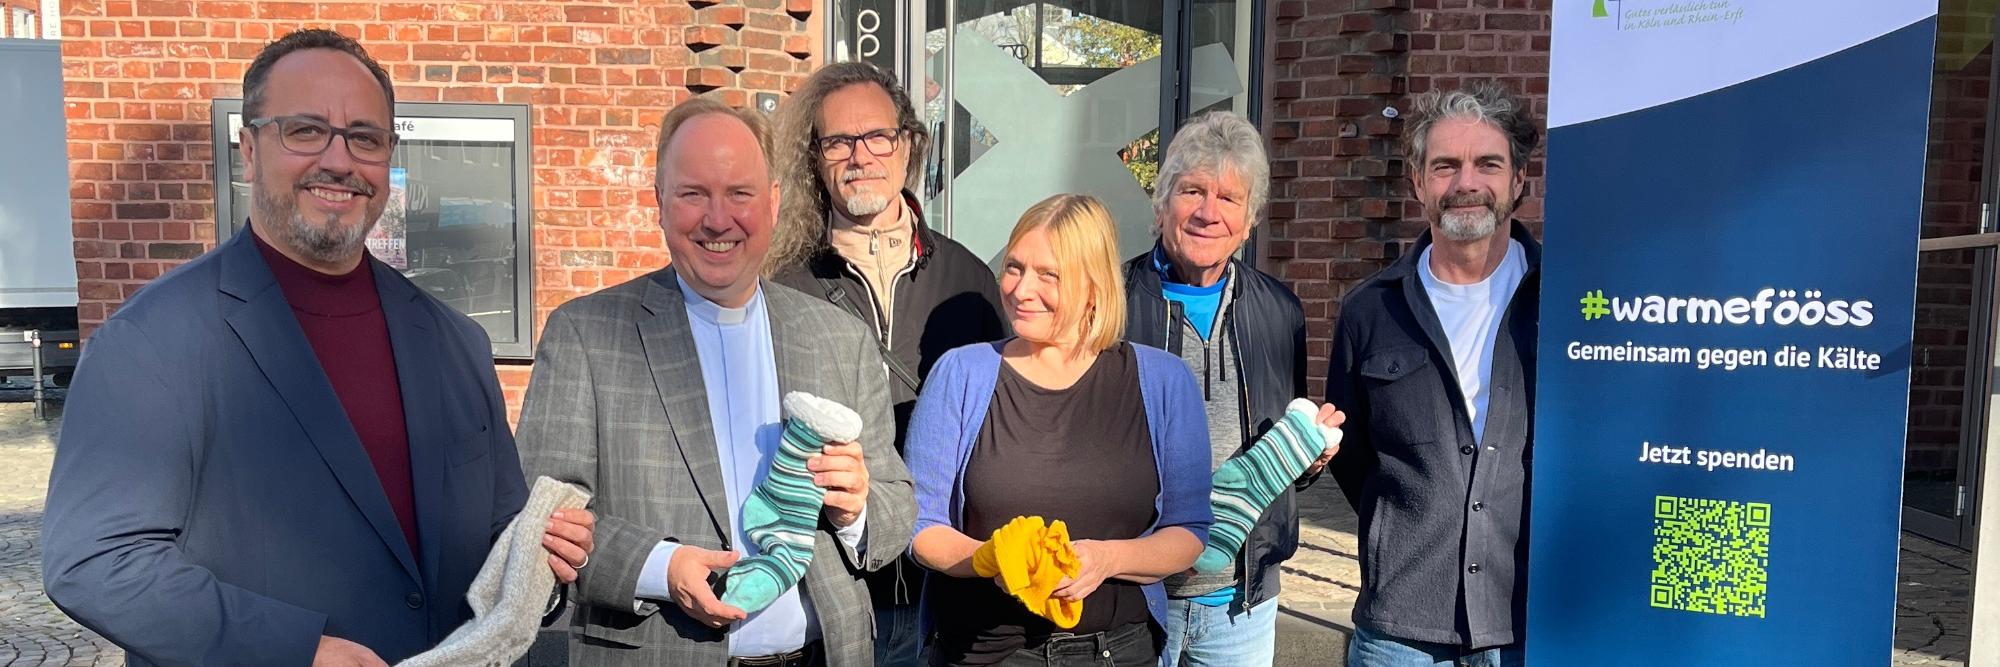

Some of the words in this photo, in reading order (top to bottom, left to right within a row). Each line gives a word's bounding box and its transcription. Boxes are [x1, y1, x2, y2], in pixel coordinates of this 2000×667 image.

[1625, 9, 1651, 19] Gutes
[1709, 0, 1729, 9] tun
[1624, 22, 1636, 30] in
[1638, 17, 1662, 29] Köln
[1664, 14, 1685, 26] und
[394, 120, 414, 132] afé
[367, 238, 405, 250] TREFFEN
[1580, 289, 1873, 327] #warmefööss
[1567, 341, 1690, 364] Gemeinsam
[1697, 346, 1767, 370] gegen
[1774, 345, 1811, 368] die
[1818, 346, 1881, 370] Kälte
[1639, 441, 1691, 465] Jetzt
[1697, 449, 1794, 472] spenden
